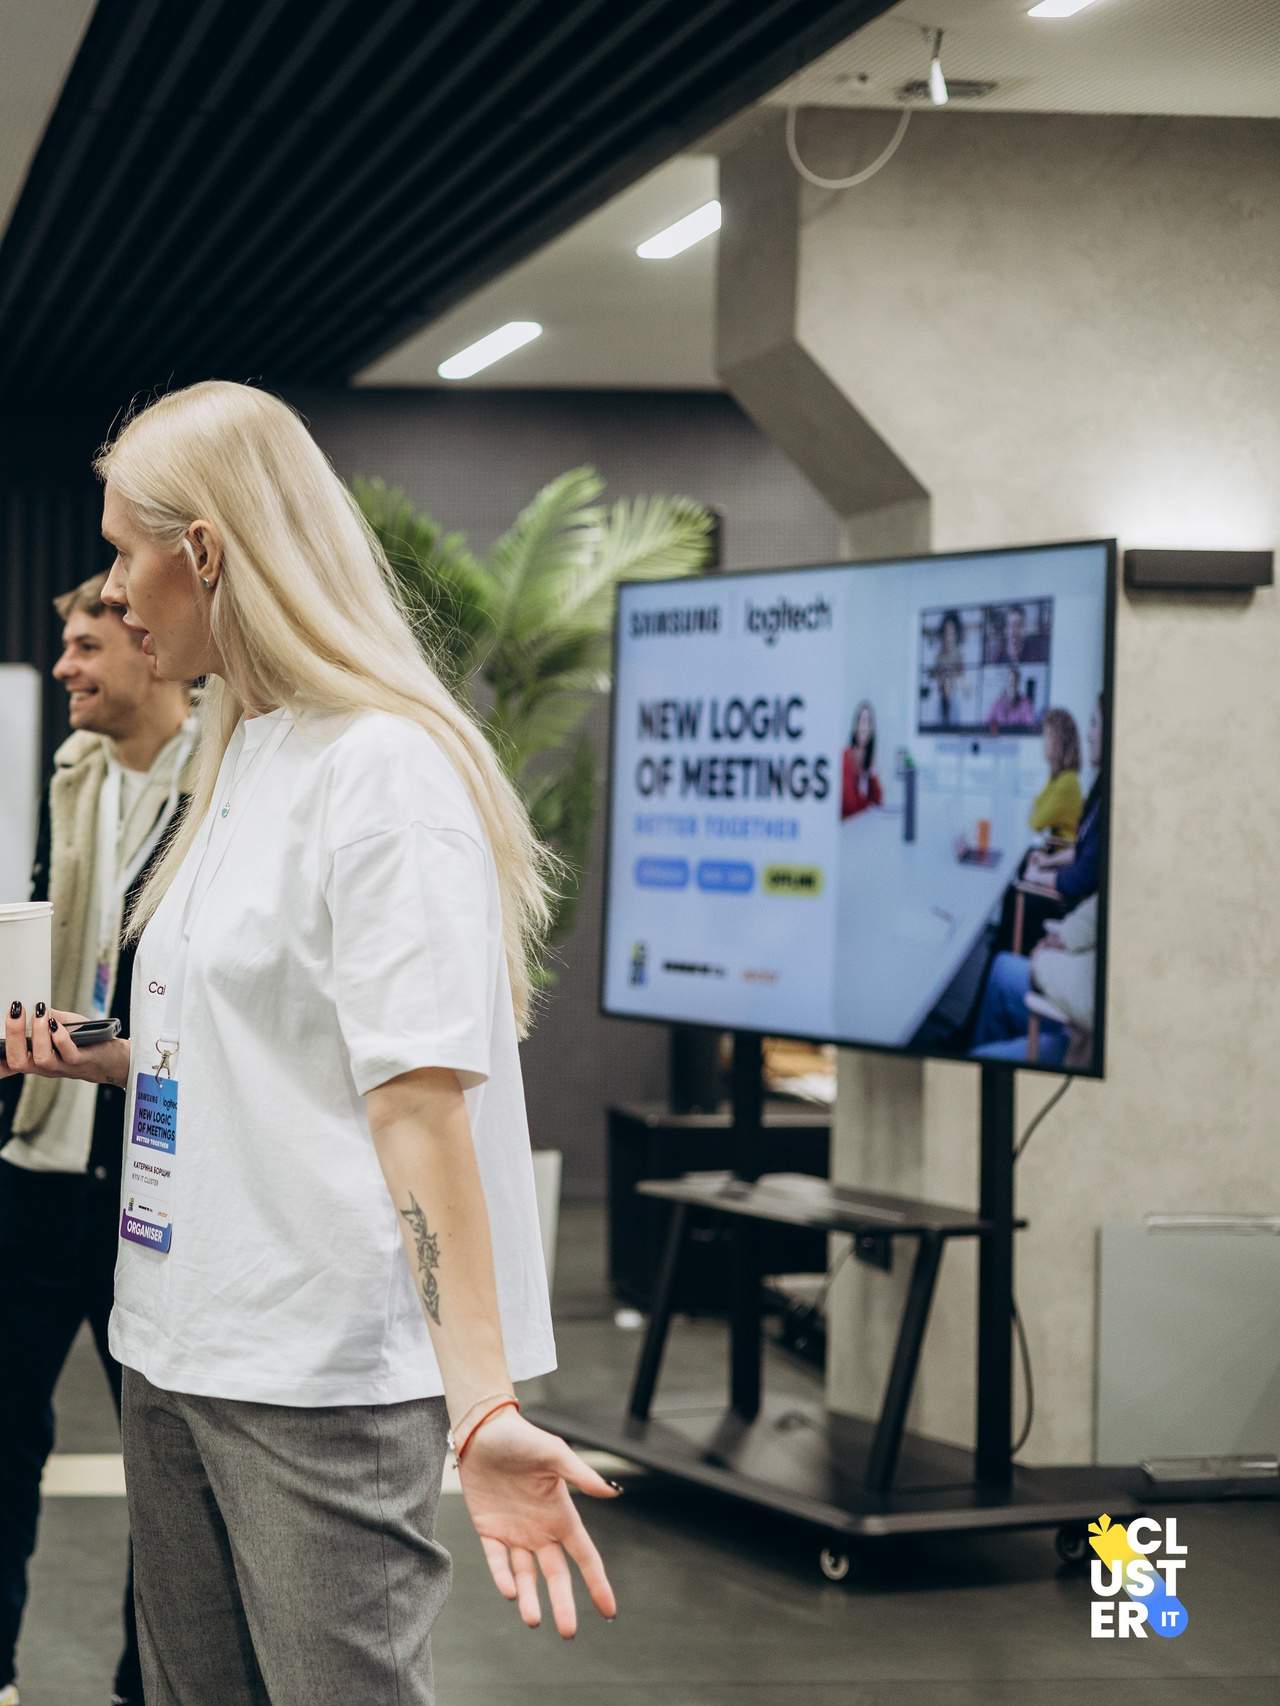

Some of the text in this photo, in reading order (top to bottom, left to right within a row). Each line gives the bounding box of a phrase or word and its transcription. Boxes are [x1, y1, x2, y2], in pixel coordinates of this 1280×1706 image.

[638, 695, 804, 741] NEW LOGIC
[636, 755, 829, 799] OF MEETINGS
[138, 1092, 158, 1104] SAMSUNG
[139, 1108, 172, 1126] NEW LOGIC
[137, 1121, 176, 1141] OF MEETINGS
[133, 1160, 153, 1173] КАТЕРИНА
[127, 1220, 163, 1243] ORGANISER
